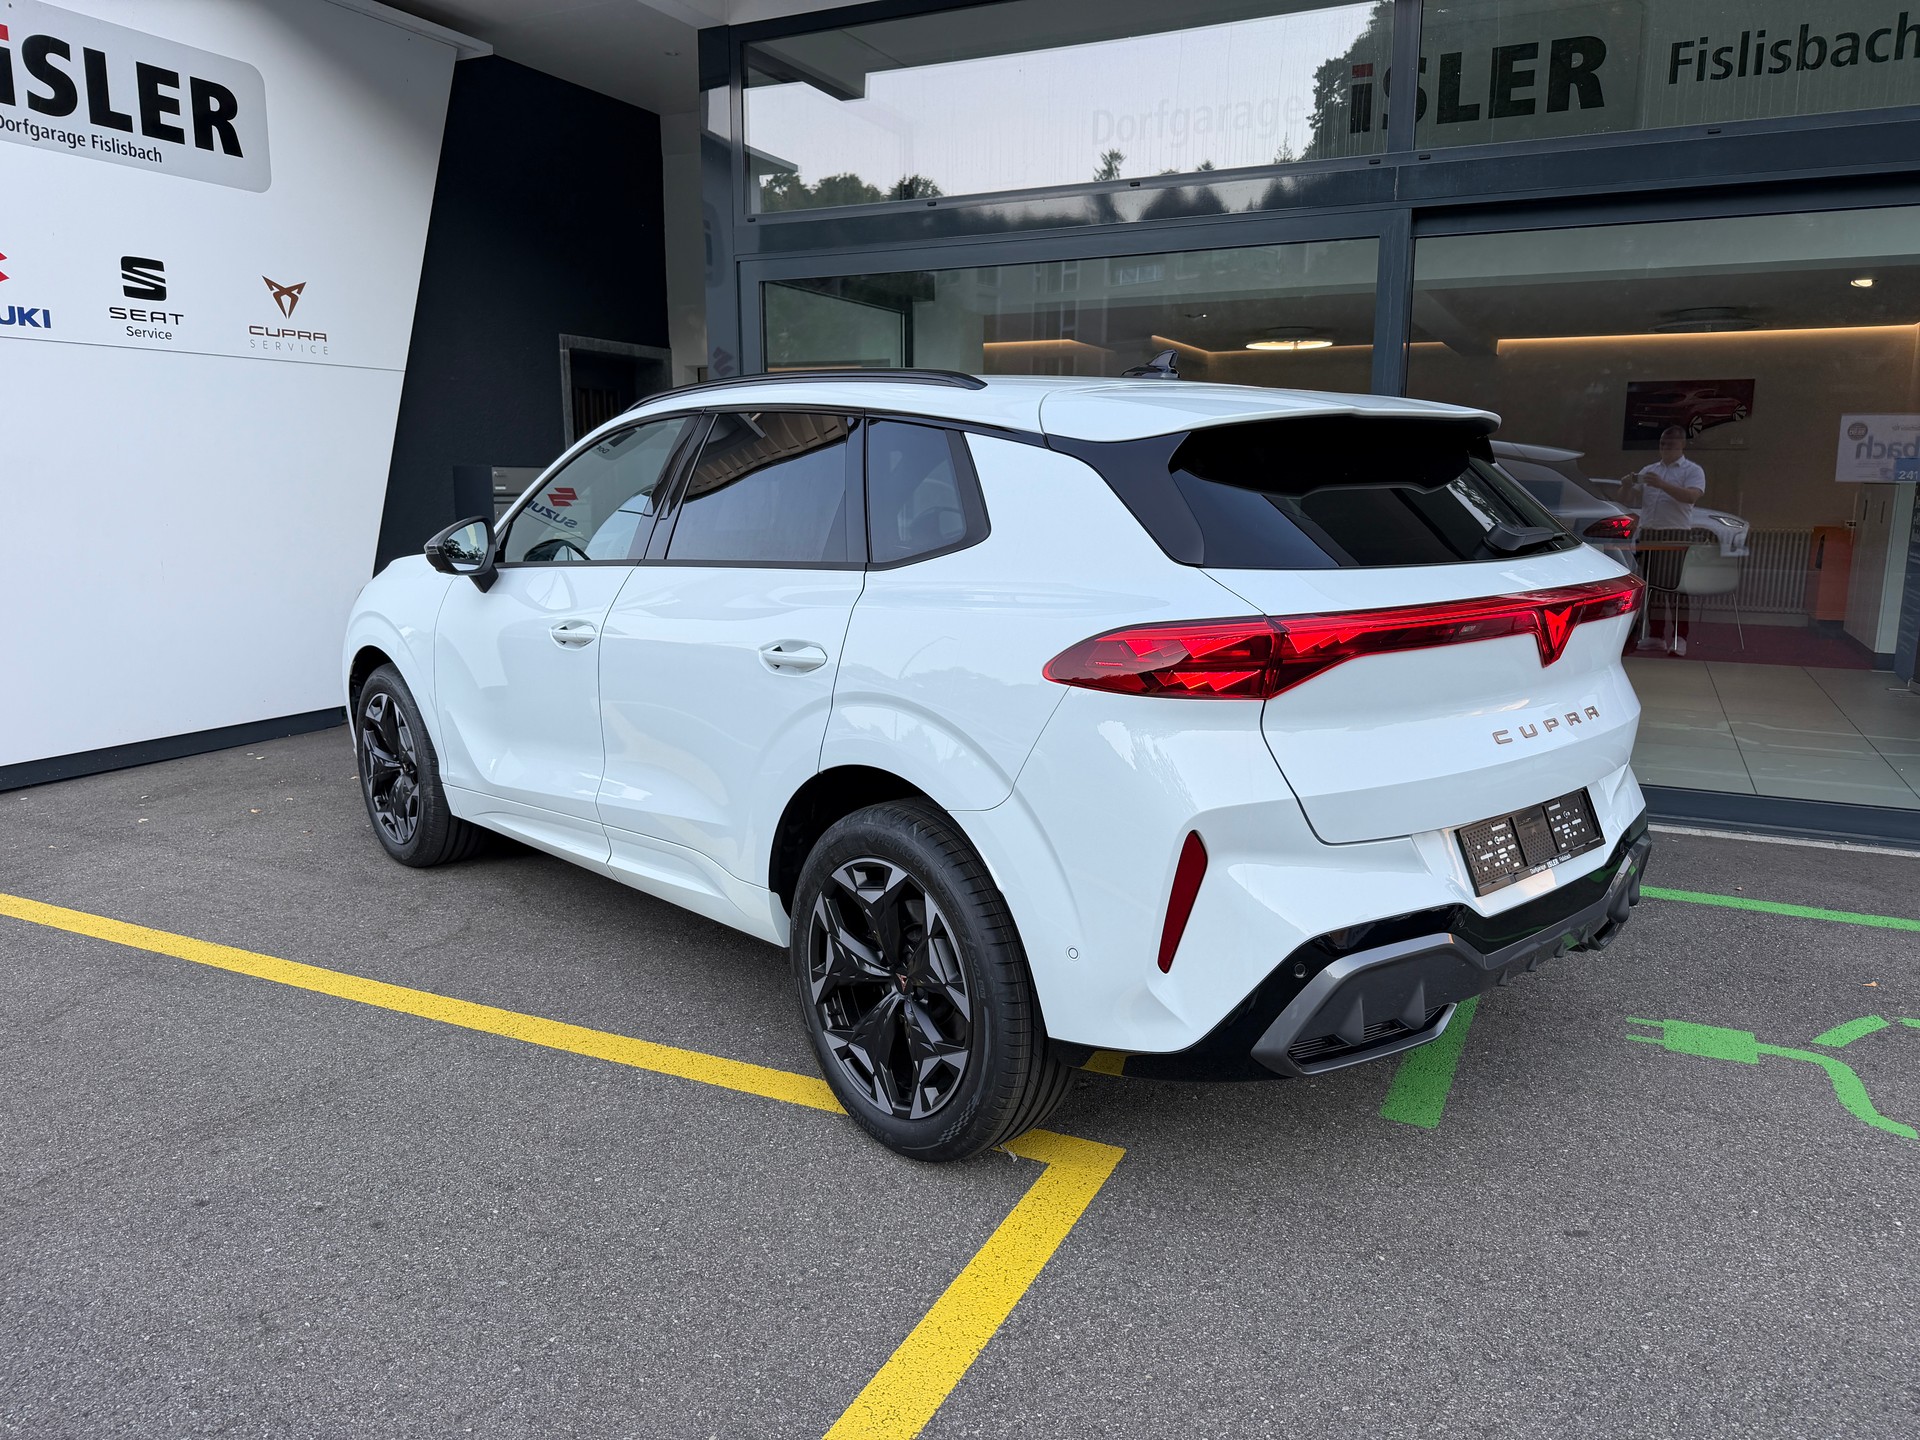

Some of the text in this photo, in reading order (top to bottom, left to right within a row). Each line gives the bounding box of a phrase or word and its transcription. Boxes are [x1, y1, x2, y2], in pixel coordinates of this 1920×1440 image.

[1092, 96, 1303, 148] Dorfgarage
[1668, 11, 1920, 85] Fislisbach
[91, 134, 163, 163] Fislisbach
[109, 306, 184, 326] SEAT
[126, 325, 173, 341] Service
[248, 325, 328, 343] CUPRA
[249, 338, 329, 356] SERVICE
[1492, 705, 1600, 745] CUPRA
